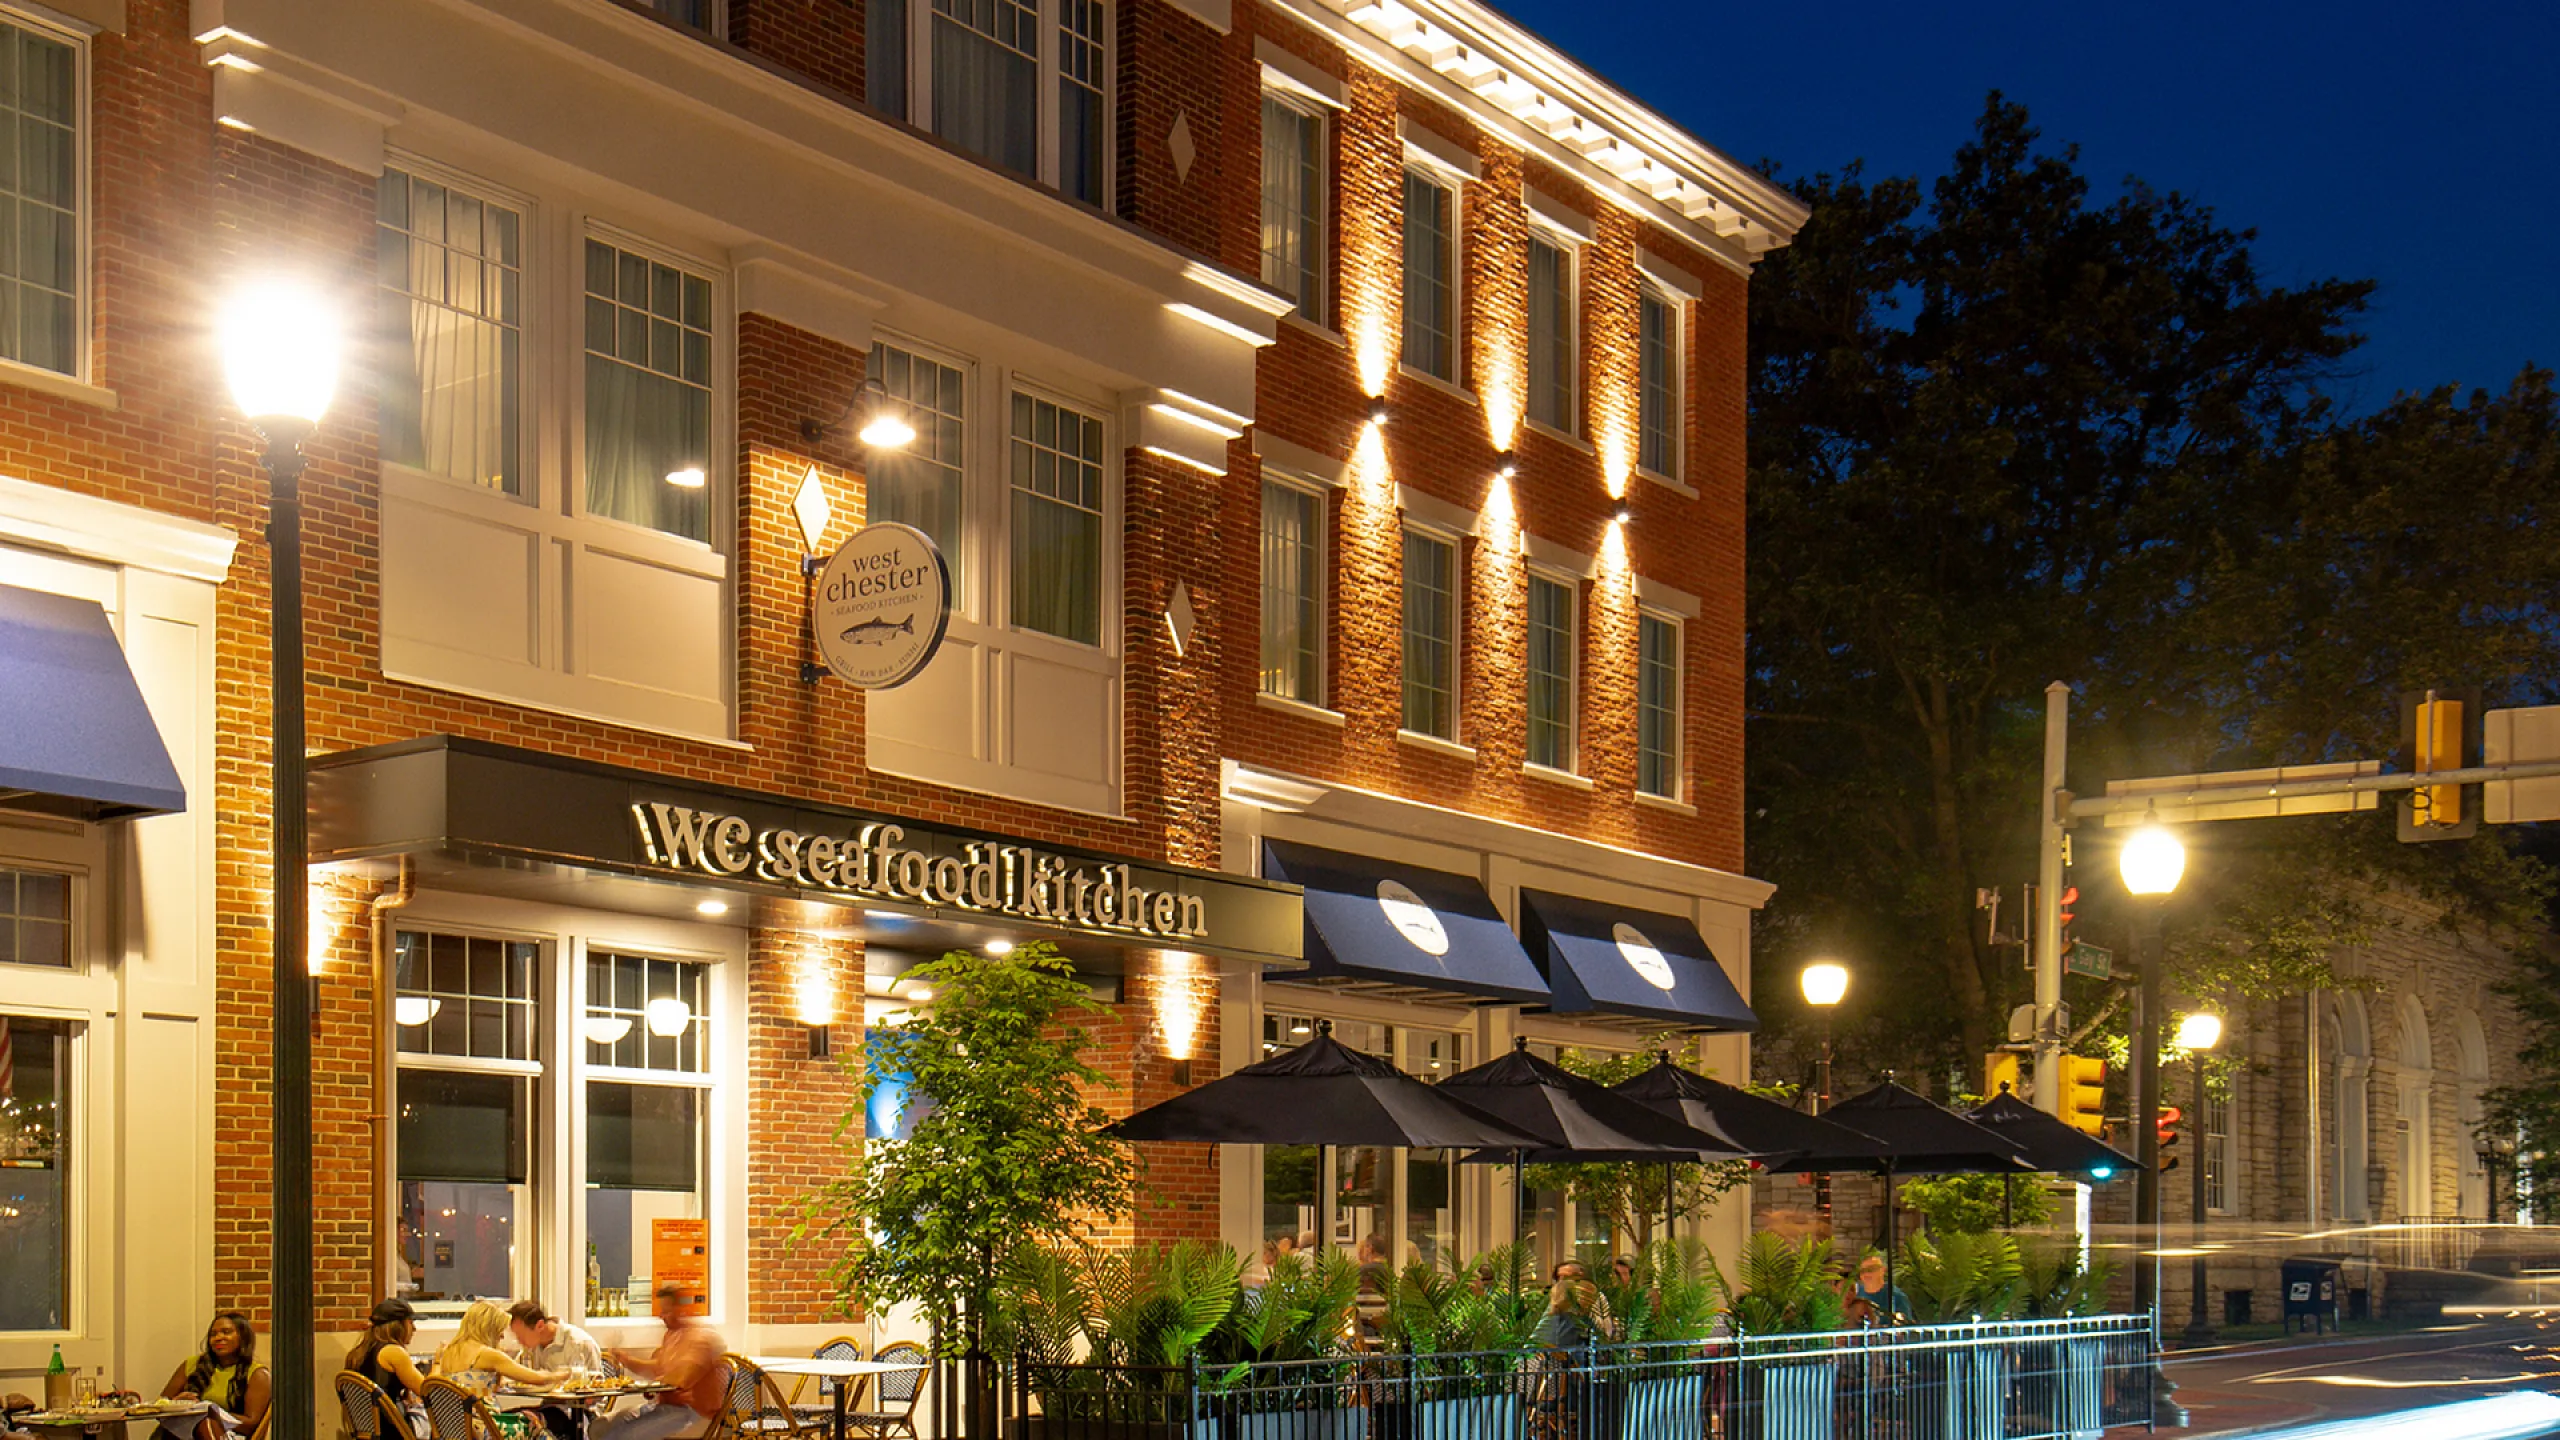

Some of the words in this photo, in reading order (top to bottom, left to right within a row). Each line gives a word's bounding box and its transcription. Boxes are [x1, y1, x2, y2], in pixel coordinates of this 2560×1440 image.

[852, 547, 902, 573] west
[826, 564, 929, 603] chester
[878, 592, 919, 609] KITCHEN
[770, 823, 1001, 909] seafood
[1014, 847, 1209, 937] kitchen
